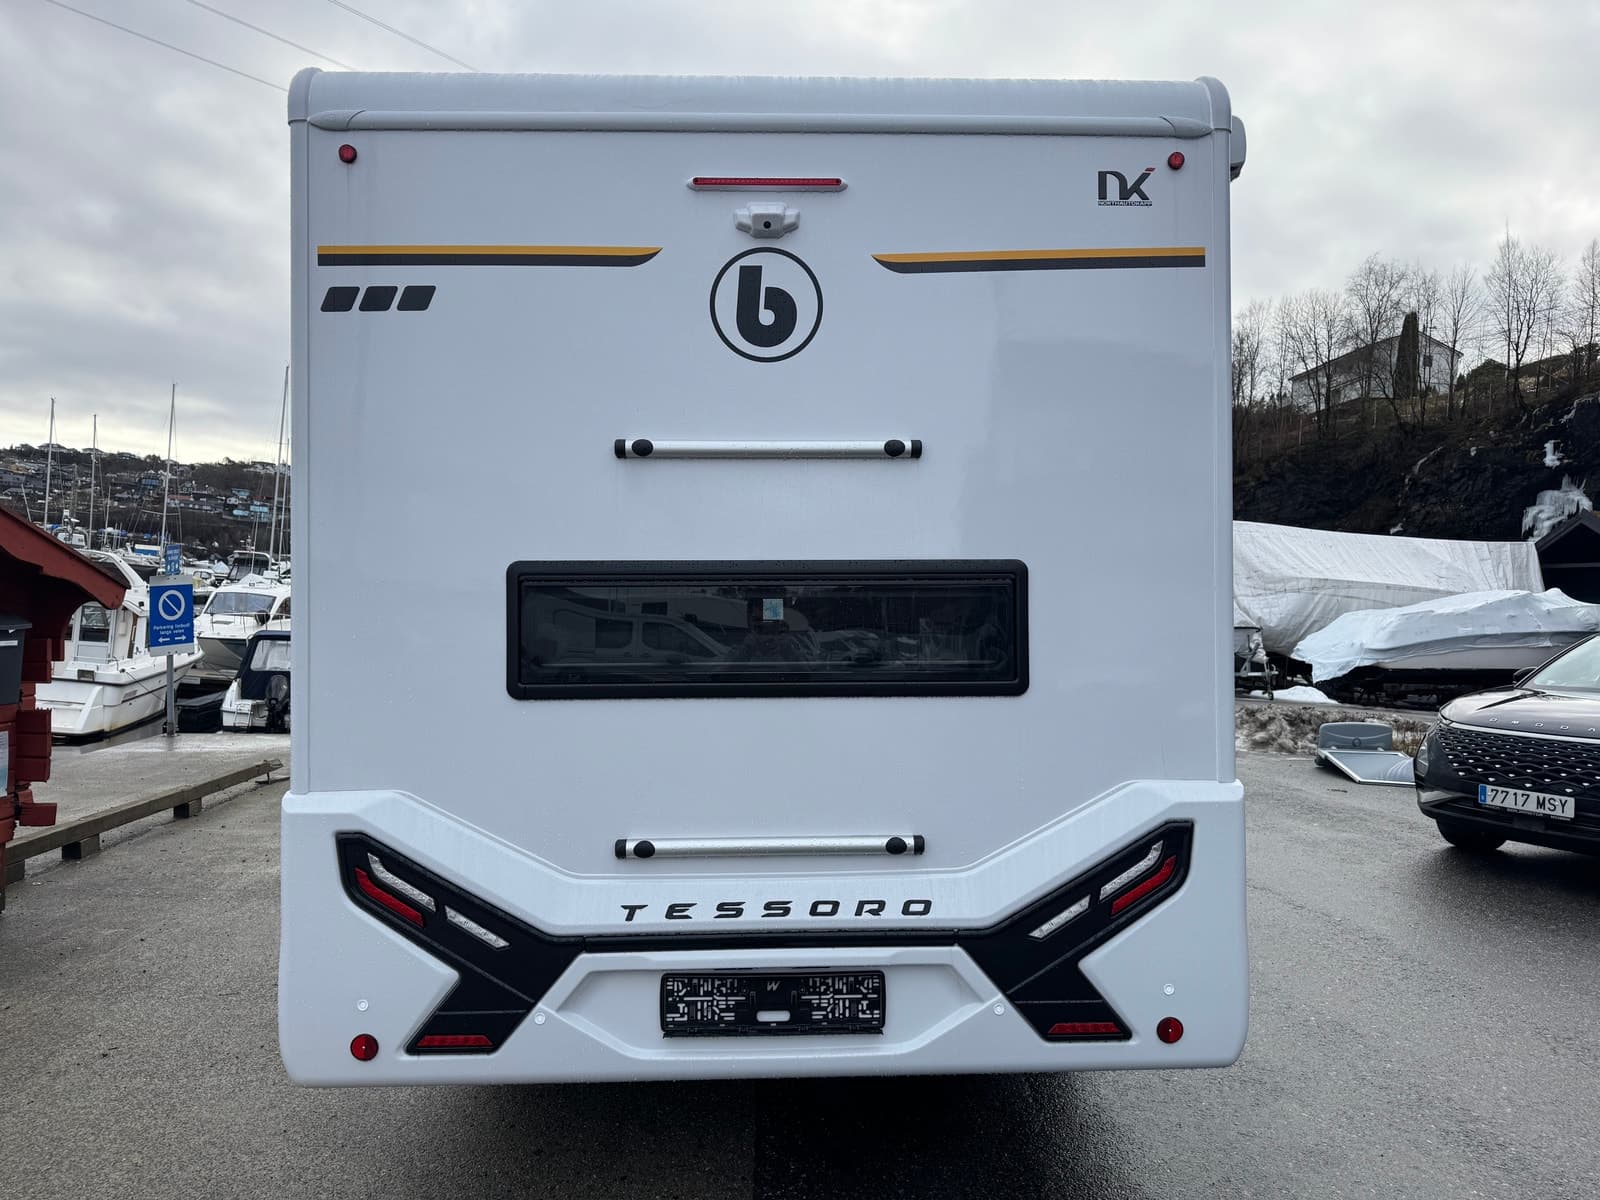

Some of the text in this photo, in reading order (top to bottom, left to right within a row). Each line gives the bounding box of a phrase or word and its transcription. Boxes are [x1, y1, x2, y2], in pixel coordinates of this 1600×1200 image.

[736, 265, 797, 347] b
[1490, 788, 1530, 808] 7717
[1536, 795, 1568, 814] MSY
[621, 899, 933, 922] TESSORO
